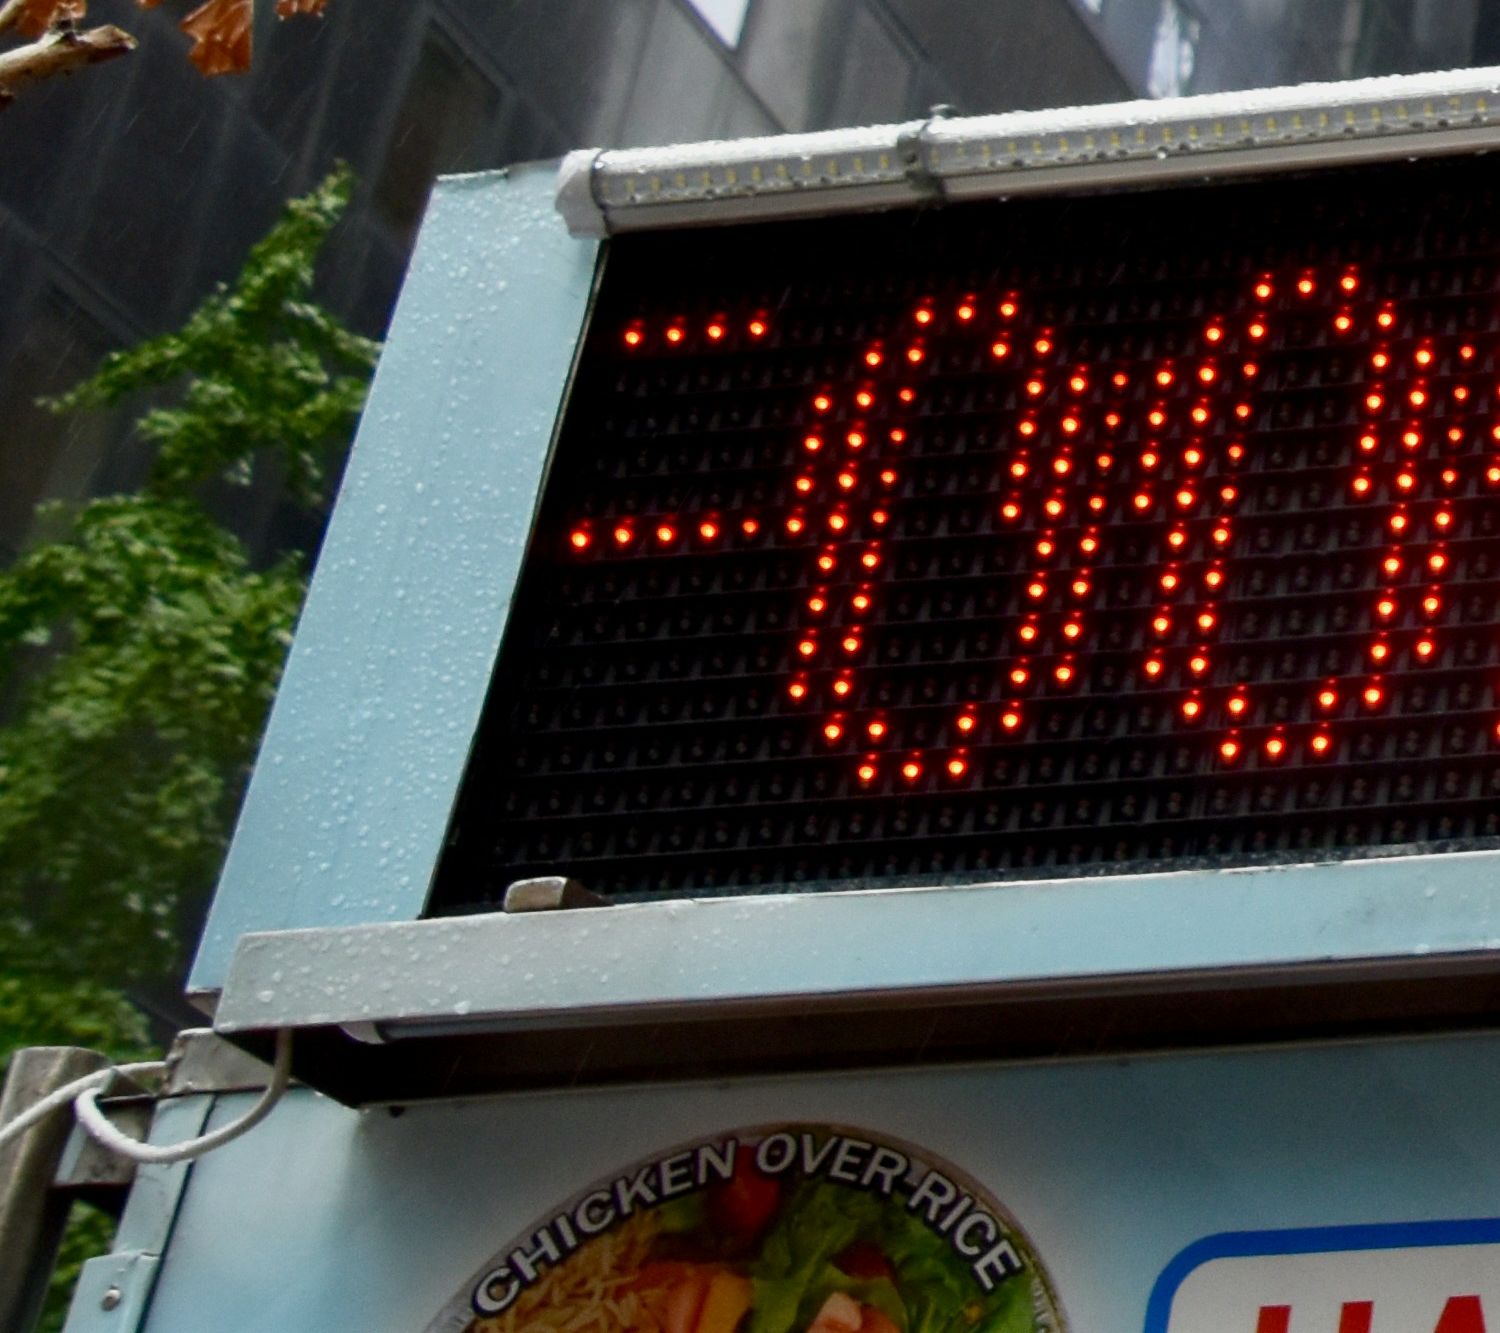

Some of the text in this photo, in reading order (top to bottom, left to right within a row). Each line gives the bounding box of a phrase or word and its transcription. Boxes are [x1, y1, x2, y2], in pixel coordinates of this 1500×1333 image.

[470, 1131, 1025, 1318] CHICKEN OVER RICE
